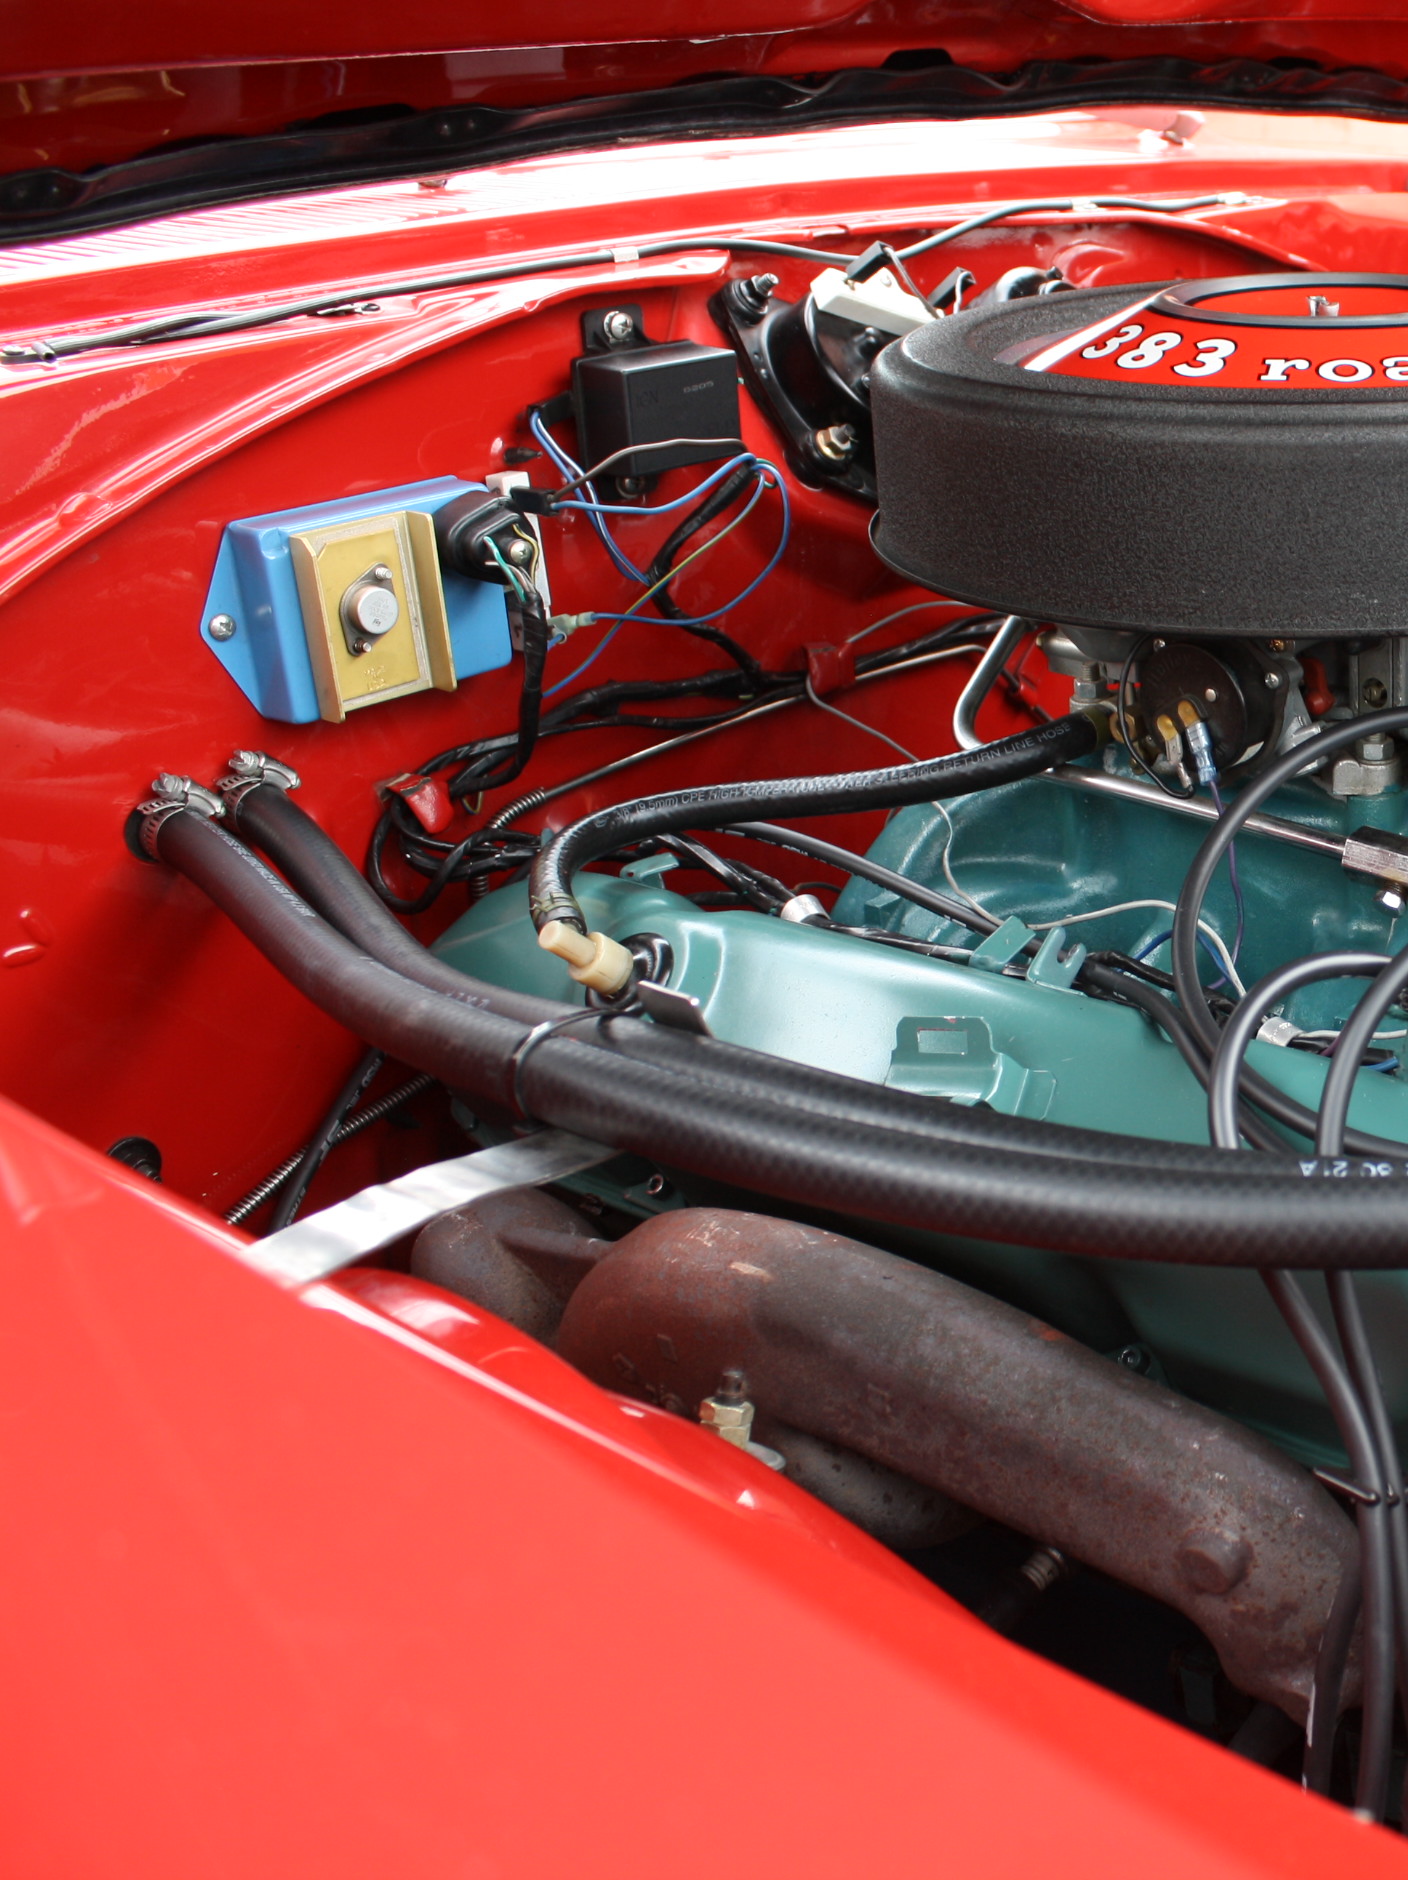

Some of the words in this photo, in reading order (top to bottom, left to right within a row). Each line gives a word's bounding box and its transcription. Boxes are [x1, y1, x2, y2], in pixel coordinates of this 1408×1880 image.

[1081, 324, 1237, 378] 383
[681, 791, 706, 805] CPE
[709, 788, 738, 801] HIGH
[943, 748, 1002, 772] RETURN
[1004, 737, 1035, 755] LINE
[1037, 722, 1072, 743] HOSE
